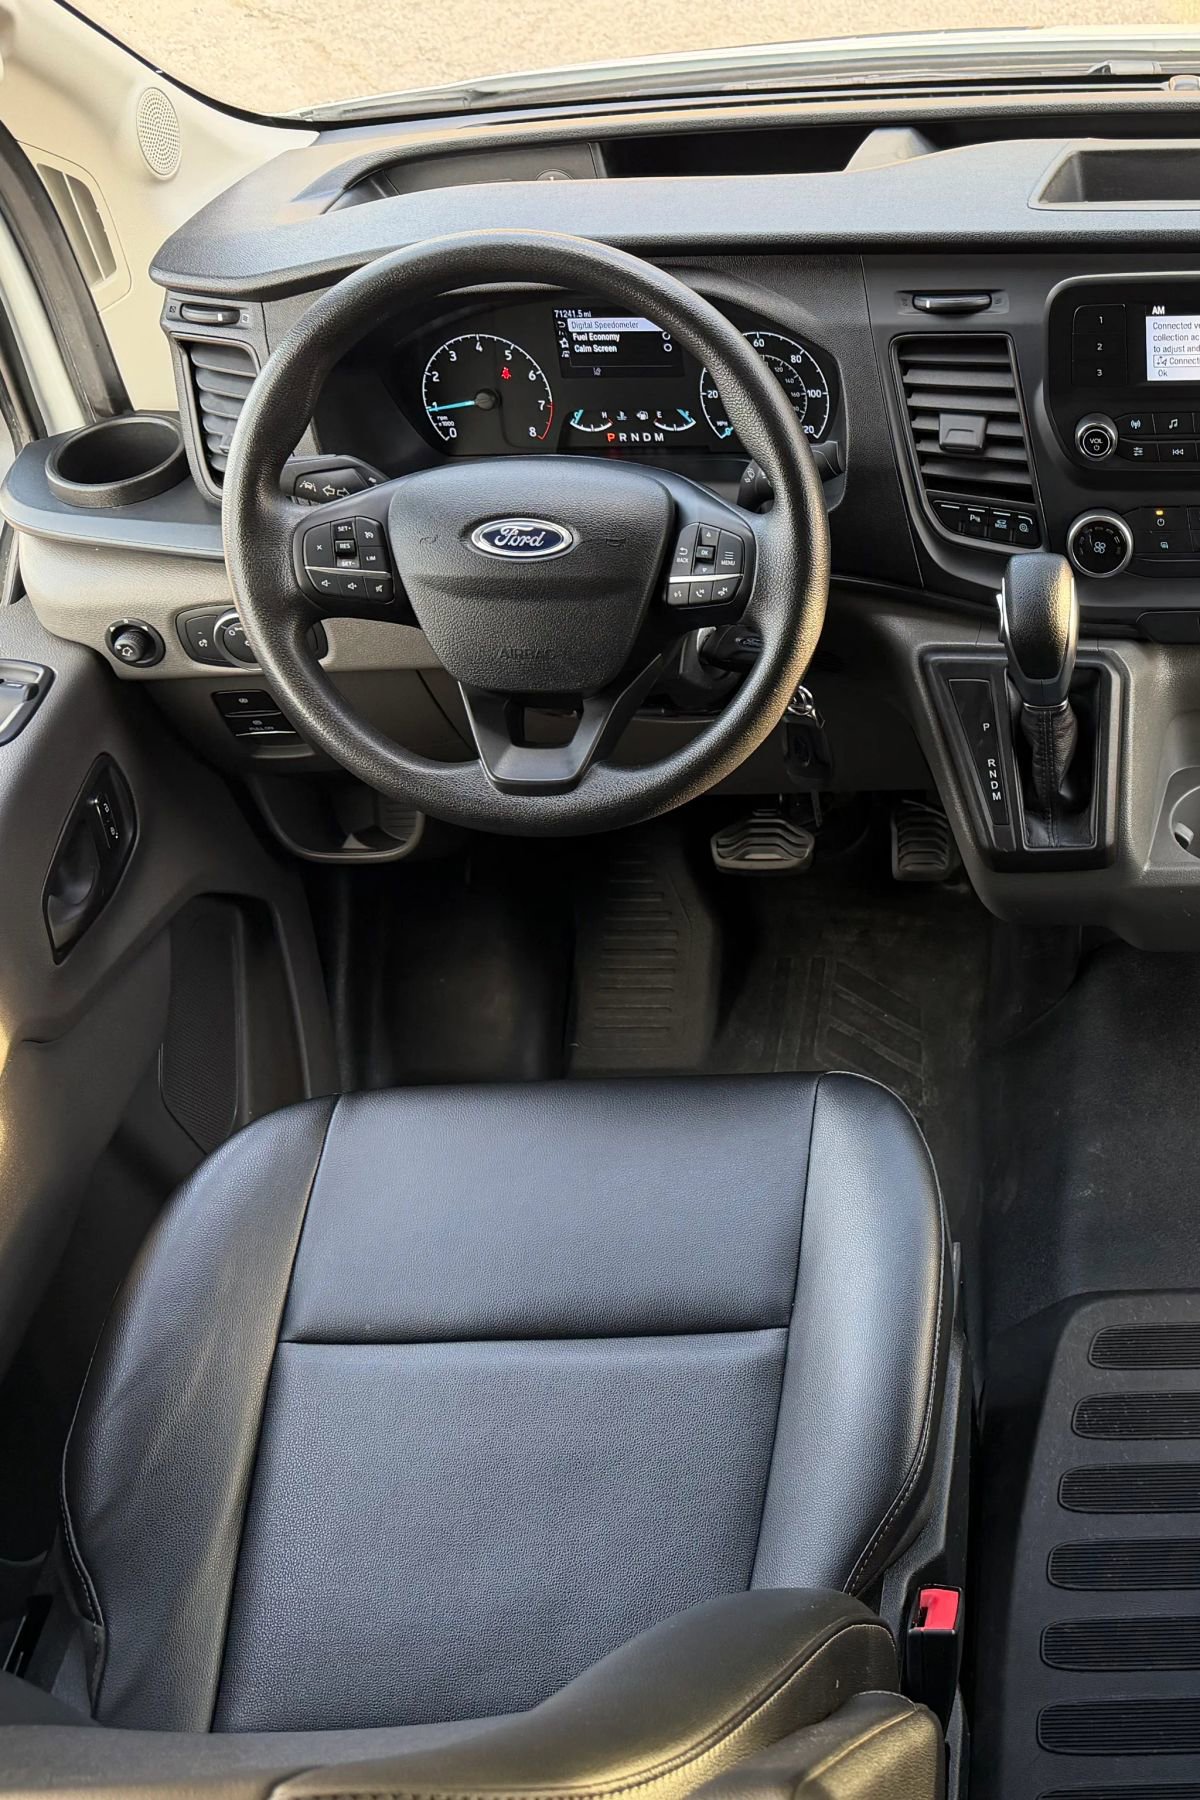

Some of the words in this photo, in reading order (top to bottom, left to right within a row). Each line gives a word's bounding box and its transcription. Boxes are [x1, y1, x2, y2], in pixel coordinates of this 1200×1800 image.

[554, 309, 583, 318] 71241.5
[1151, 305, 1165, 315] AM
[571, 321, 593, 330] Digital
[594, 321, 639, 330] Speedometer
[1152, 321, 1192, 330] Connected
[572, 332, 588, 341] Fuel
[589, 332, 620, 342] Economy
[1152, 333, 1188, 341] collection
[475, 341, 483, 352] 4
[753, 339, 765, 348] 60
[1097, 342, 1103, 351] 2
[574, 344, 592, 353] Calm
[592, 344, 618, 353] Screen
[1153, 345, 1160, 353] to
[1162, 345, 1185, 354] adjust
[449, 351, 457, 362] 3
[505, 350, 512, 361] 5
[791, 354, 802, 364] 80
[432, 371, 440, 382] 2
[528, 370, 536, 381] 6
[1096, 369, 1103, 377] 3
[1157, 369, 1168, 377] Ok
[707, 390, 718, 399] 20
[806, 389, 822, 398] 100
[538, 400, 546, 410] 7
[449, 427, 458, 438] 0
[529, 427, 537, 437] 8
[803, 425, 815, 434] 20
[607, 432, 616, 442] P
[619, 432, 627, 442] R
[631, 432, 640, 442] N
[642, 432, 652, 442] D
[654, 432, 664, 442] M
[494, 525, 547, 547] Ford
[982, 722, 990, 732] P
[987, 758, 996, 768] R
[989, 770, 997, 779] N
[990, 781, 999, 790] D
[992, 792, 1002, 801] M
